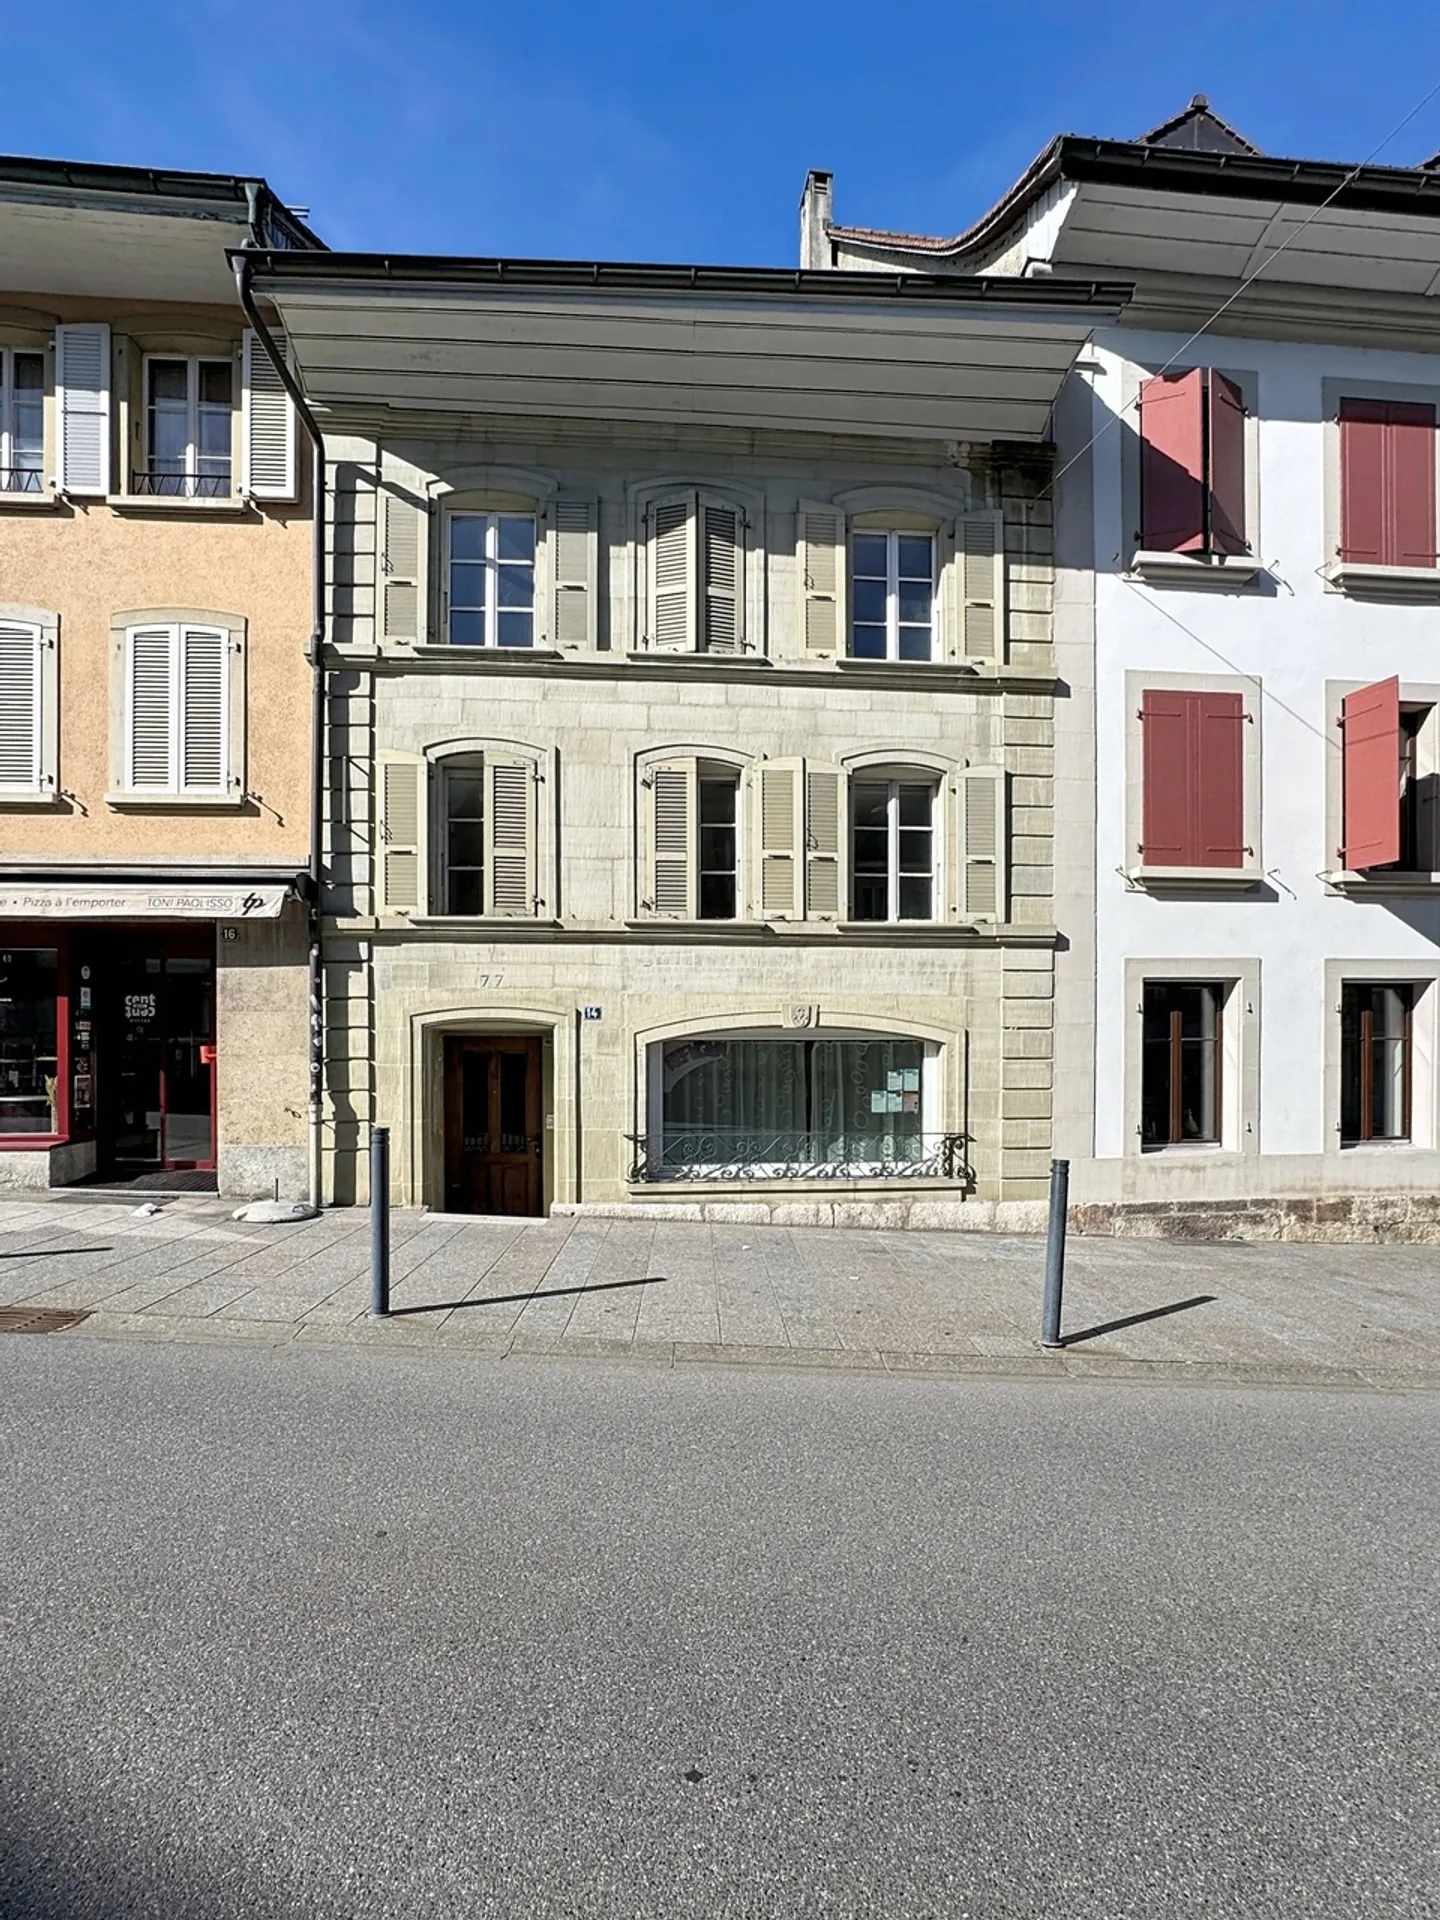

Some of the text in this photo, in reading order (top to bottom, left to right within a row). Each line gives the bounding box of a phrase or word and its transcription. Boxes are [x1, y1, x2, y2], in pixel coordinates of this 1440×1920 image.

[22, 896, 52, 907] Pizza
[66, 897, 127, 908] l'emporter
[147, 898, 174, 908] TONI
[223, 928, 236, 940] 16
[124, 993, 156, 1006] cent
[586, 1007, 599, 1019] 14
